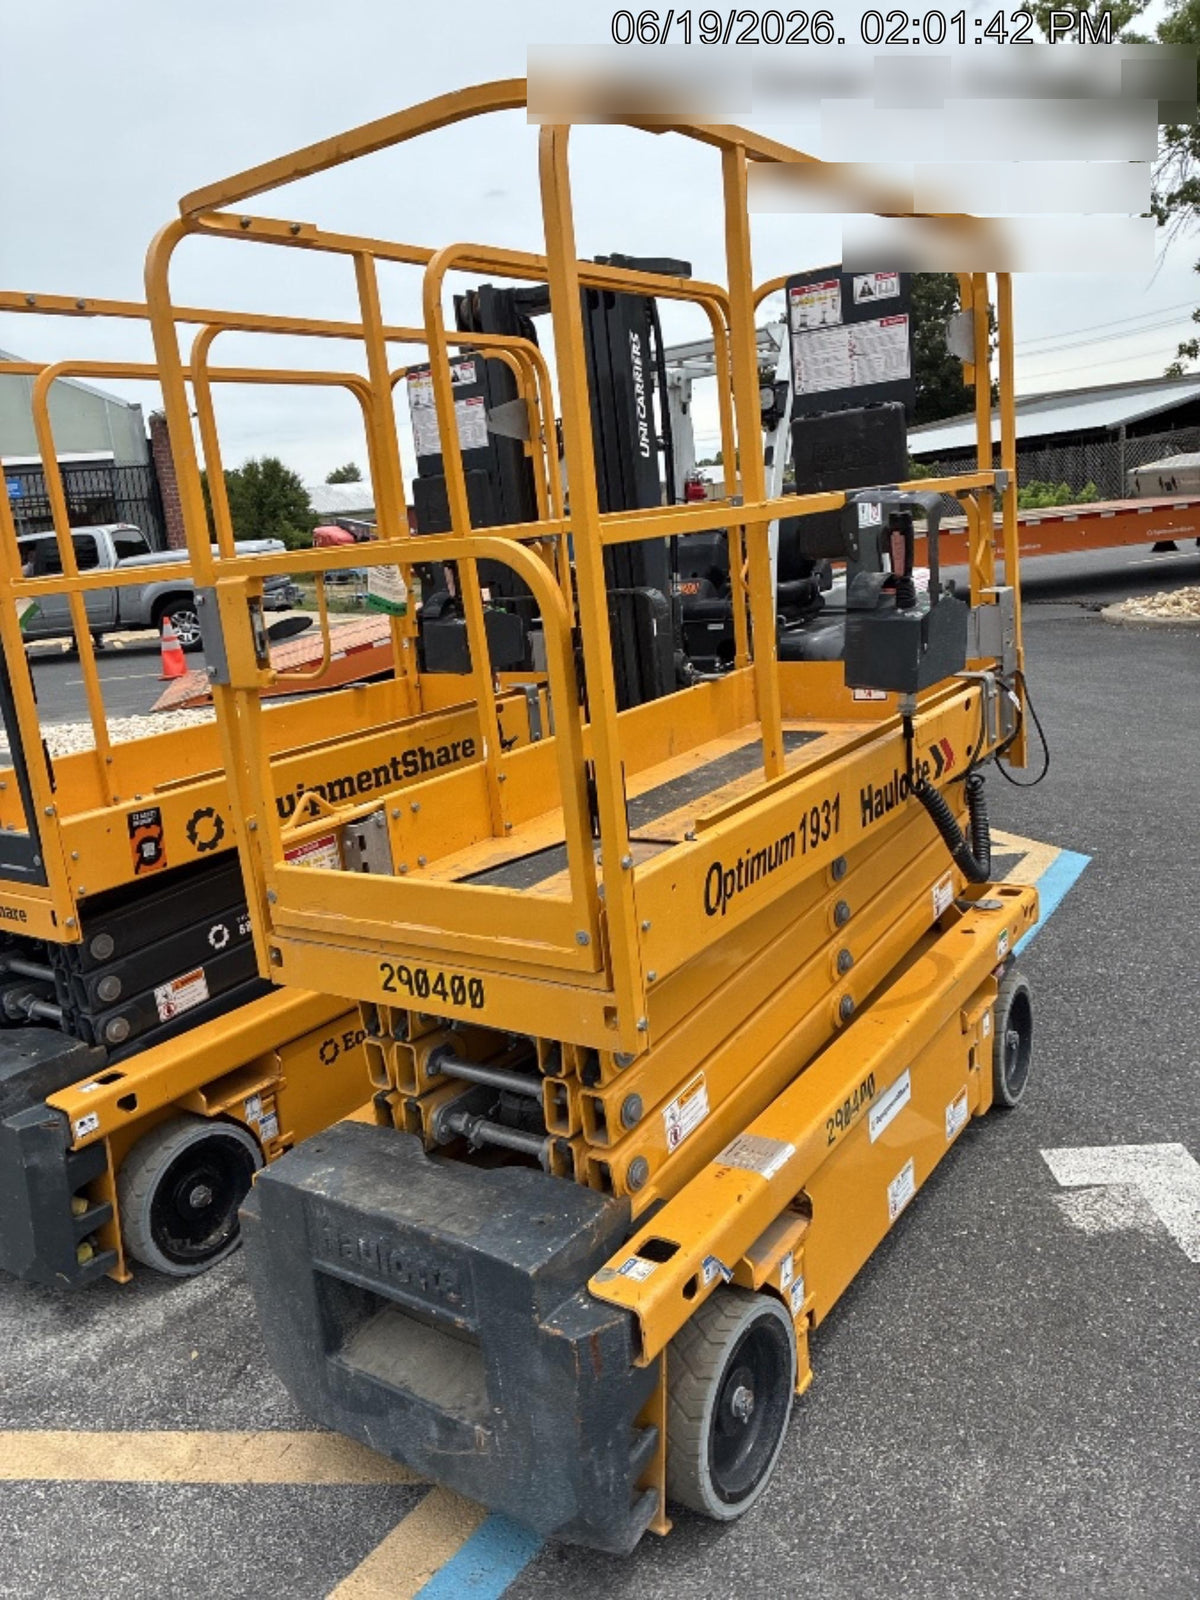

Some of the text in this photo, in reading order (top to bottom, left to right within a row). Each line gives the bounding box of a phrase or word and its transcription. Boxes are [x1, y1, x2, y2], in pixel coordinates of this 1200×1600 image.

[629, 328, 650, 458] UNICARRIERS
[703, 791, 841, 918] Optimum 1931
[379, 962, 484, 1009] 290400
[826, 1071, 875, 1147] 290400
